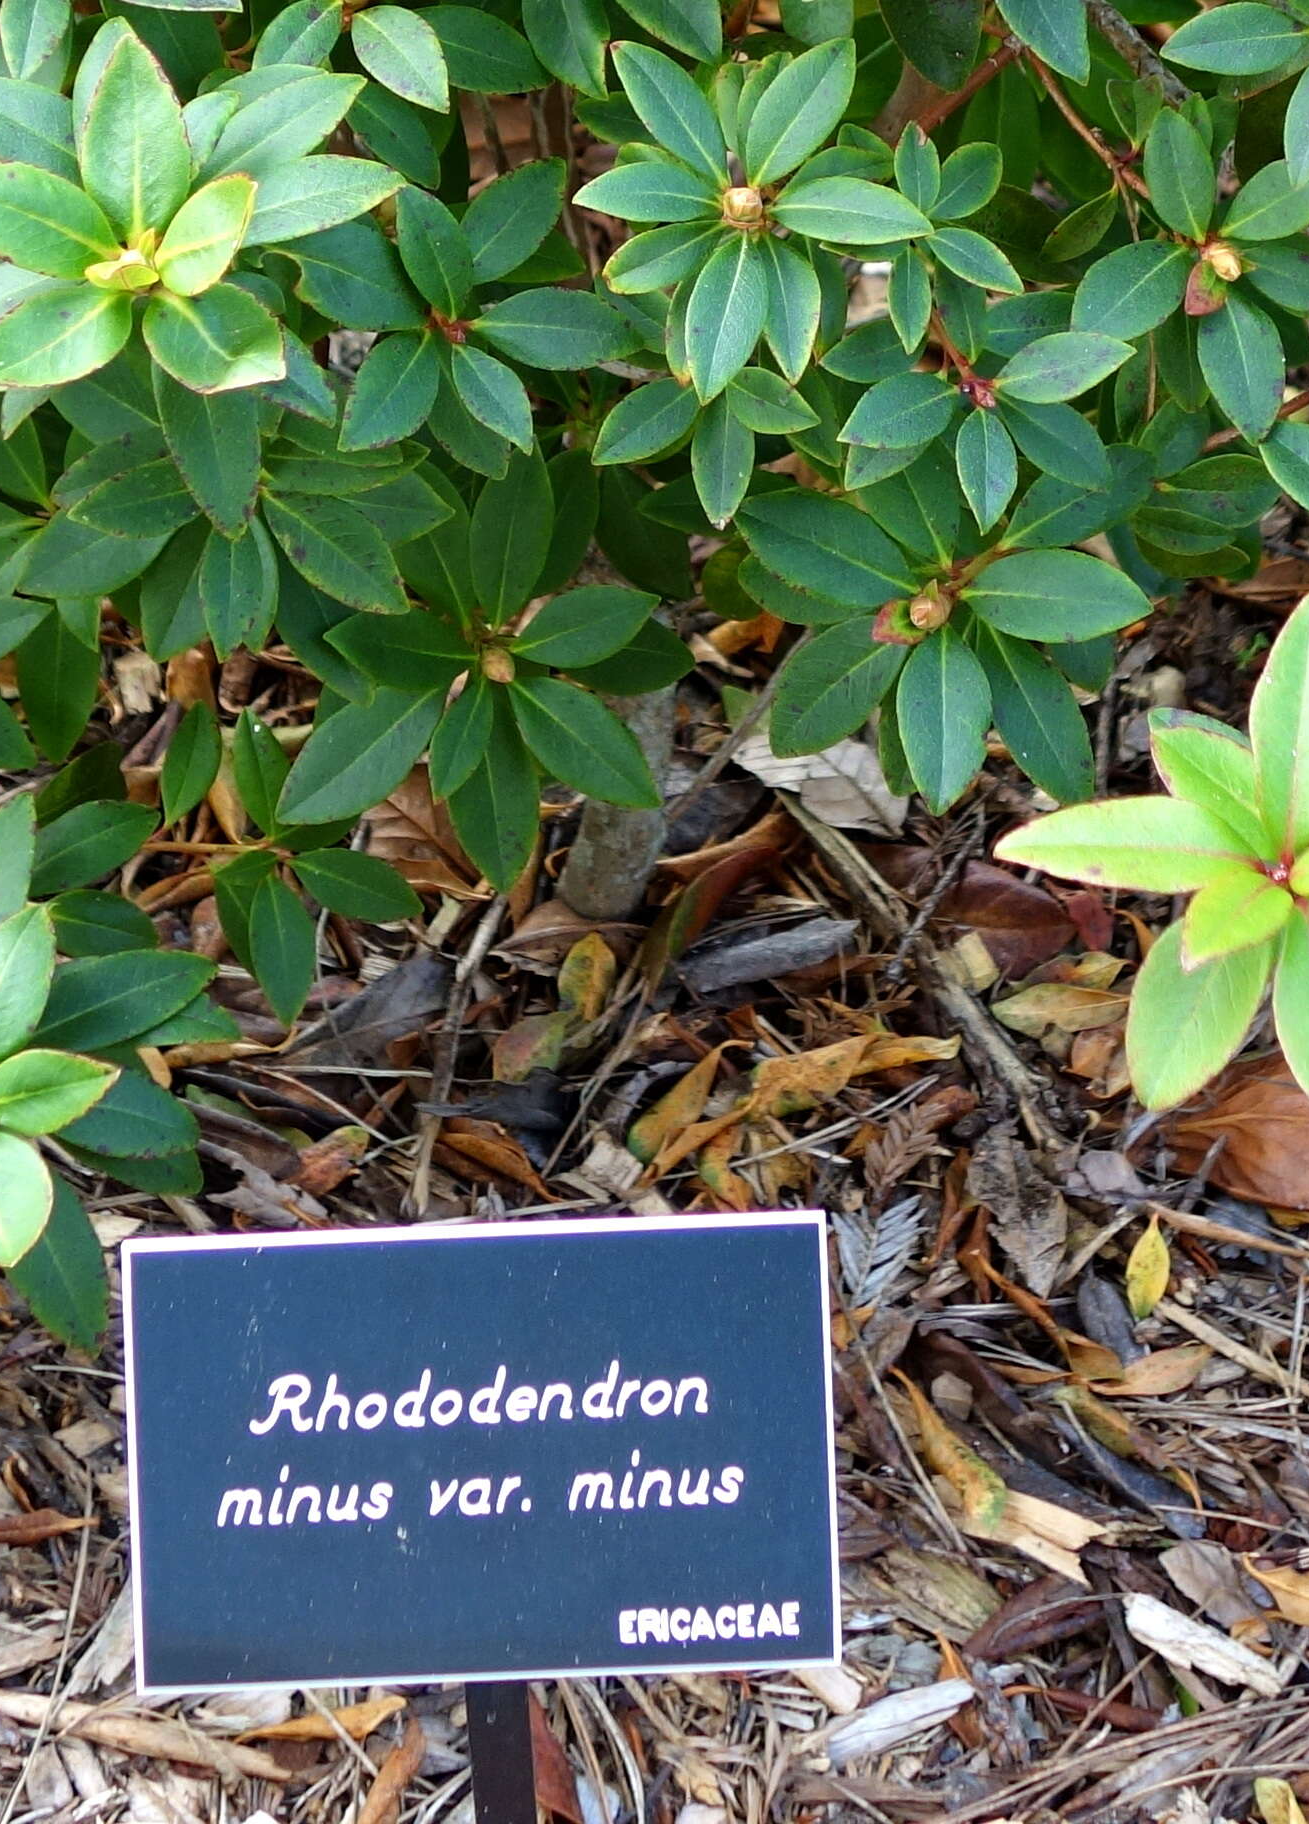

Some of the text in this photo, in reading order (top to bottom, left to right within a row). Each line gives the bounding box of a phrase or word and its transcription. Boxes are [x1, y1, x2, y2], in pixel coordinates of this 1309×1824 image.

[248, 1359, 710, 1435] Rhododendron
[216, 1449, 745, 1528] minus var. minus
[618, 1601, 801, 1645] ERICACEAE
